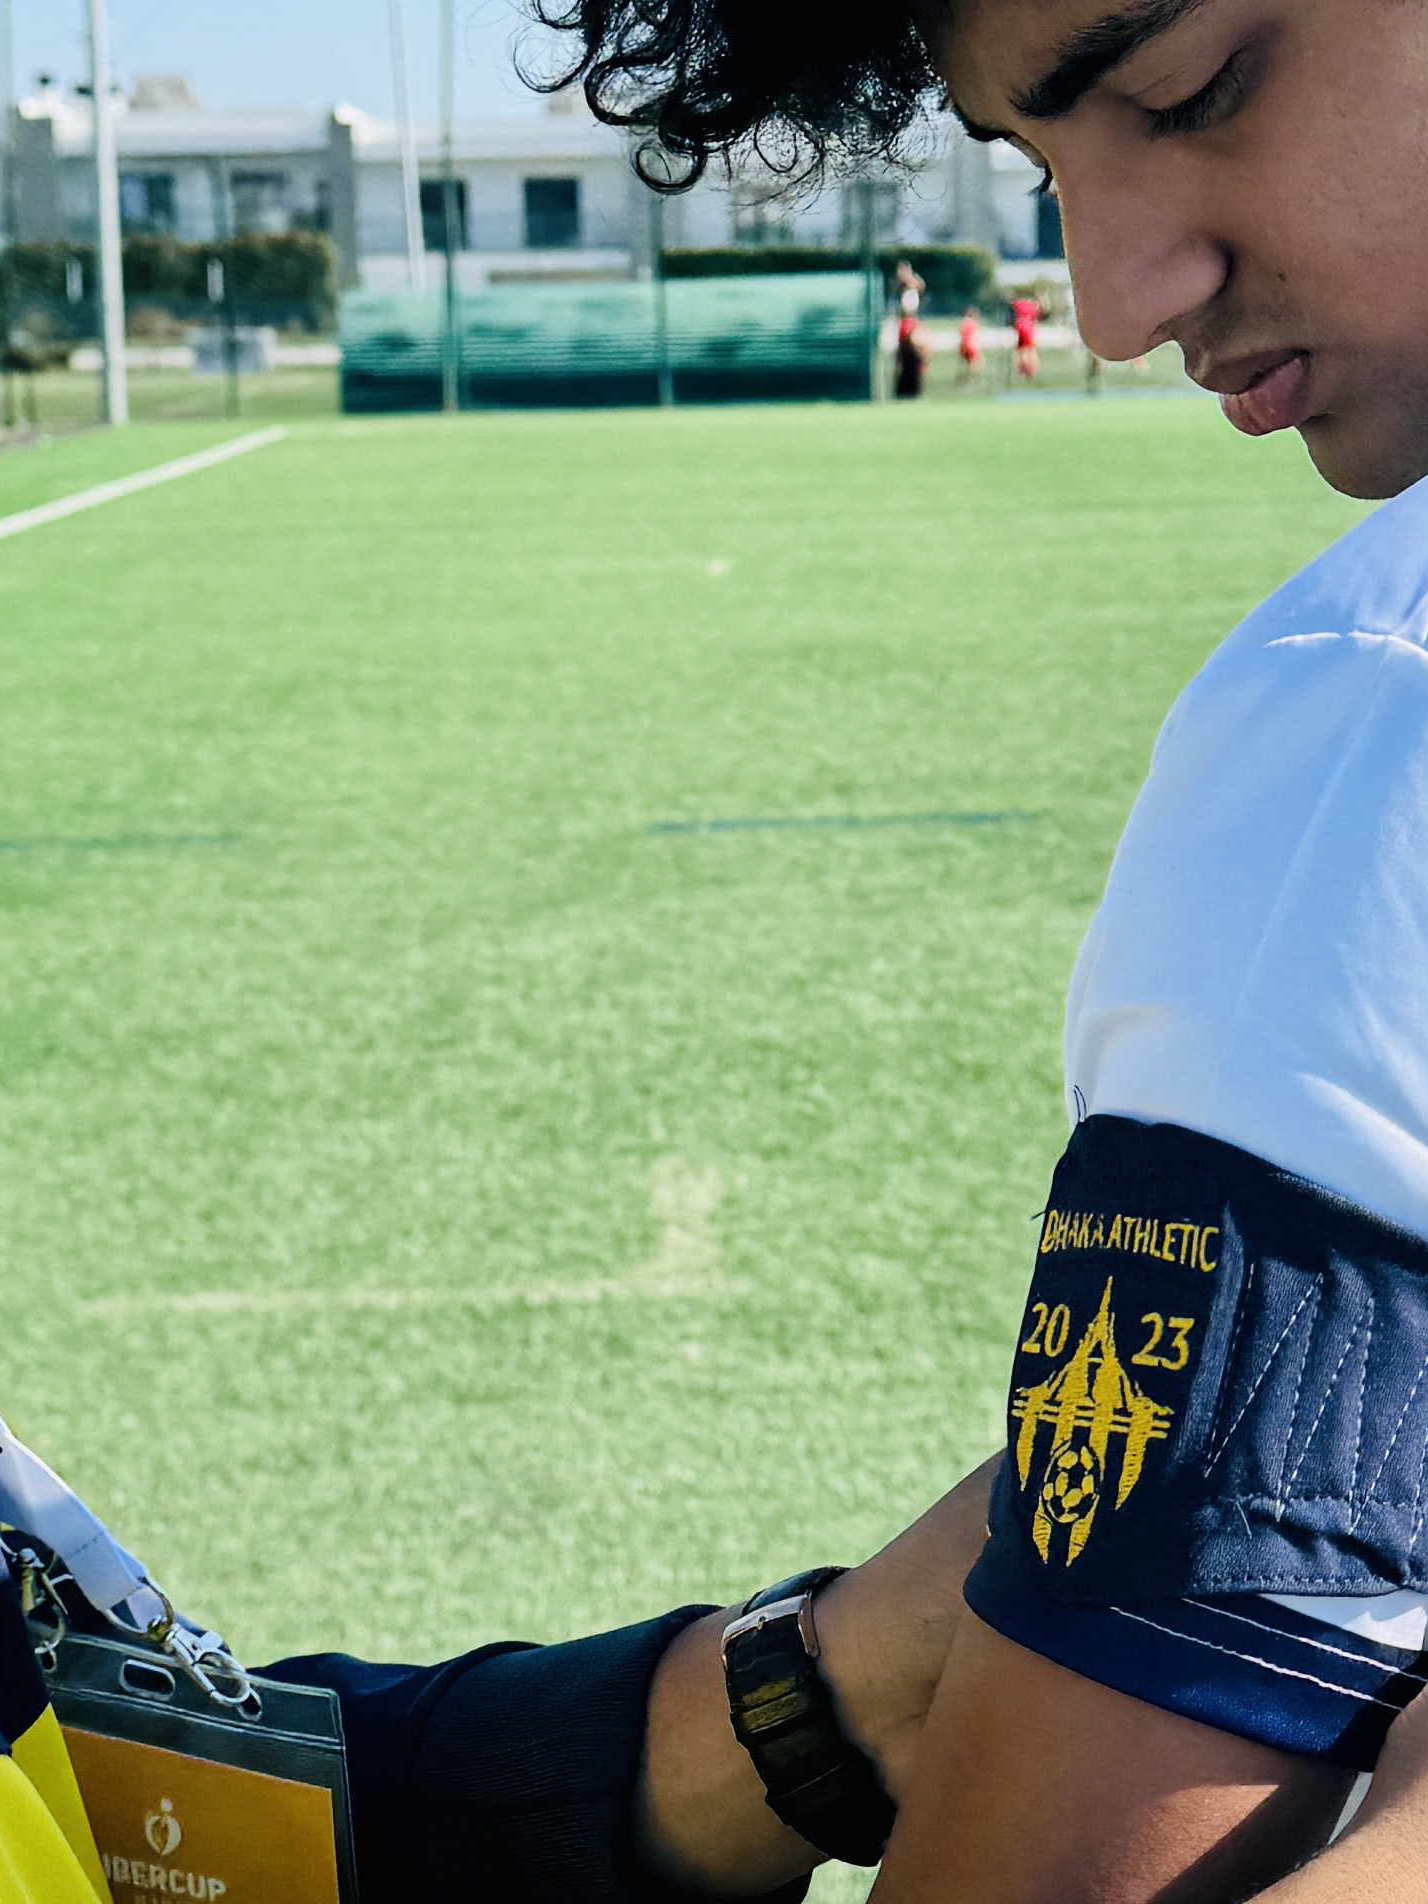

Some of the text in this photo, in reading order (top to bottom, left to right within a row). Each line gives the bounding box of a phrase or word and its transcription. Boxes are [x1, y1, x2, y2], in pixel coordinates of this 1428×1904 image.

[1040, 1209, 1220, 1273] DHAKA ATHLETIC
[1021, 1302, 1195, 1371] 20 23
